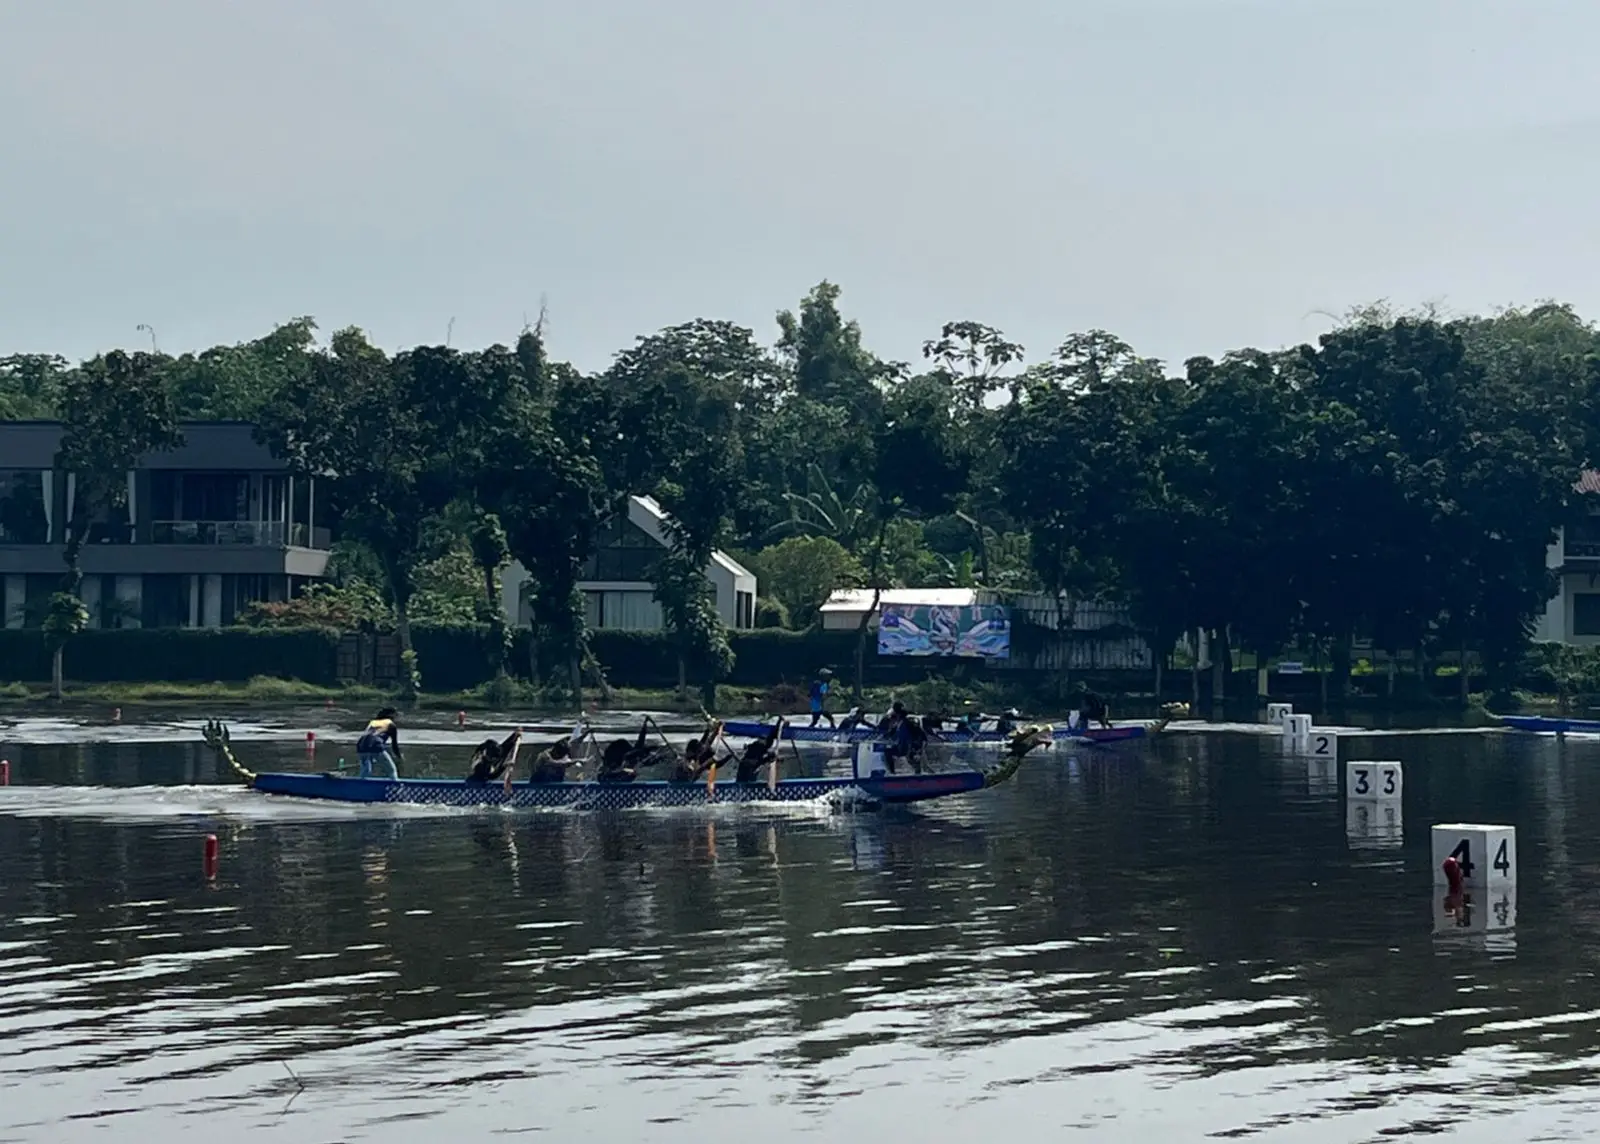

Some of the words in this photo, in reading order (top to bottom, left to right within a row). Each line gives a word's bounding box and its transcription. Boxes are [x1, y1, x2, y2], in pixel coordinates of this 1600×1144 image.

[1290, 719, 1296, 733] 1
[1315, 737, 1329, 754] 2
[1355, 770, 1369, 794] 3
[1384, 770, 1395, 794] 3
[1448, 839, 1475, 878] 4
[1493, 838, 1510, 877] 4
